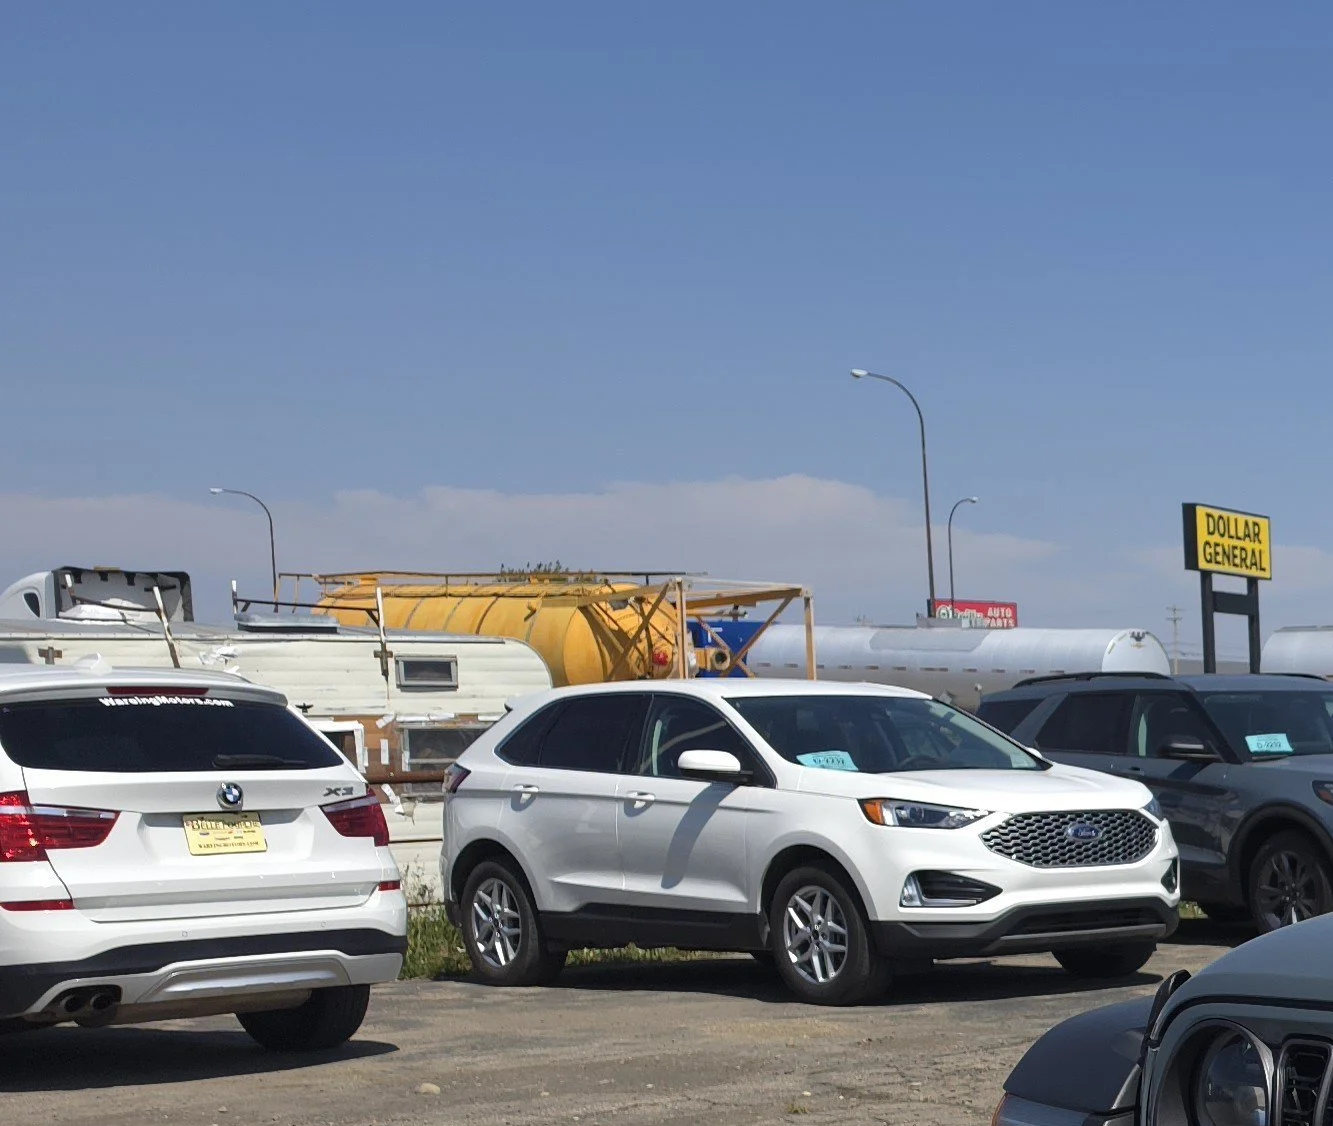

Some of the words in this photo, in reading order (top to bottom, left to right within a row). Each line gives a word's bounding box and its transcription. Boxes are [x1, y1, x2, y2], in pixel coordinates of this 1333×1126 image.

[1205, 511, 1262, 545] DOLLAR
[1202, 540, 1267, 573] GENERAL
[987, 607, 1013, 618] AUTO
